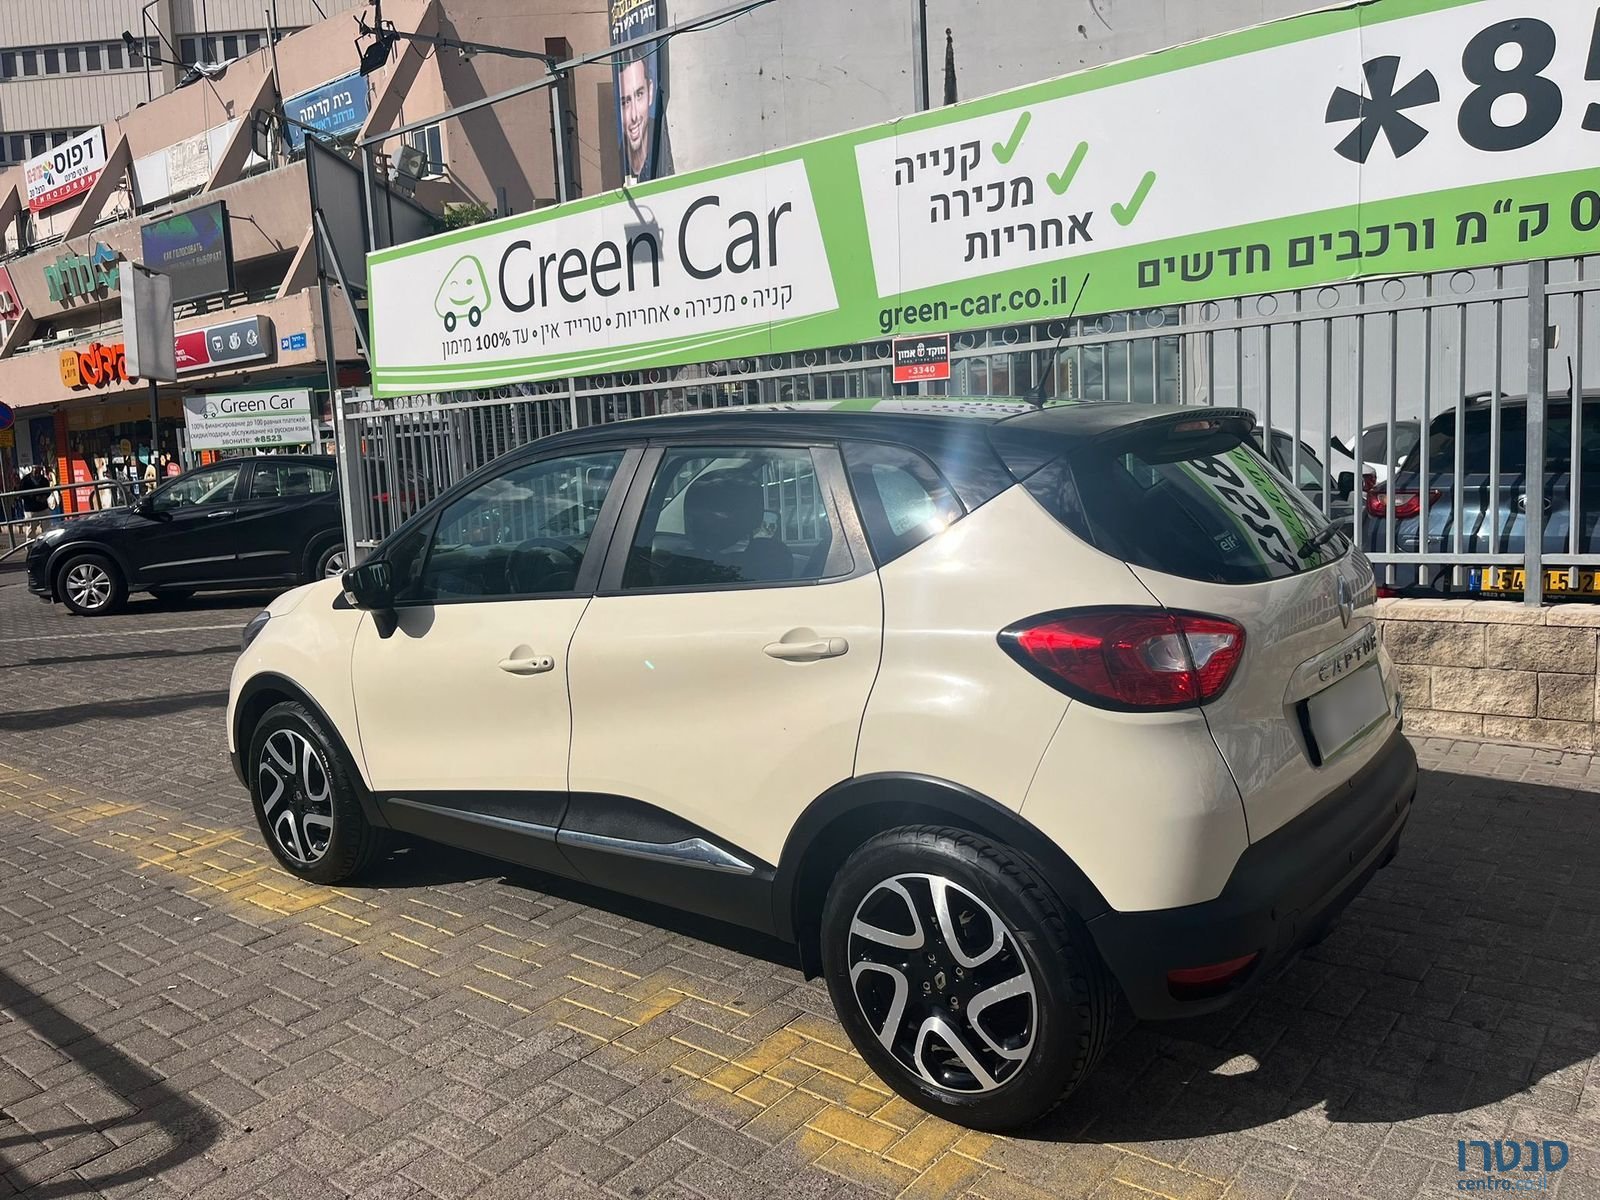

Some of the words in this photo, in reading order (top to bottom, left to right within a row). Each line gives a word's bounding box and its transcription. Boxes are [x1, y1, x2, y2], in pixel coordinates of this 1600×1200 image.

[299, 98, 330, 122] קדימה
[333, 91, 353, 109] בית
[53, 137, 94, 175] דפוס
[894, 139, 981, 186] קנייה
[930, 175, 1034, 224] מכירה
[964, 210, 1094, 262] אחריות
[1288, 217, 1436, 268] ורכבים
[498, 231, 661, 314] Green
[678, 195, 792, 280] Car
[1137, 243, 1271, 289] חדשים
[685, 293, 736, 320] מכירה
[752, 283, 793, 309] קניה
[878, 275, 1067, 334] green-car.co.il
[564, 315, 602, 339] טרייד
[615, 303, 670, 330] אחריות
[475, 330, 511, 352] 100%
[512, 328, 529, 346] עד
[540, 322, 560, 345] אין
[441, 339, 473, 361] מימון
[897, 349, 916, 361] אמון
[926, 346, 946, 357] מוקד
[220, 398, 266, 414] Green
[269, 394, 295, 410] Car
